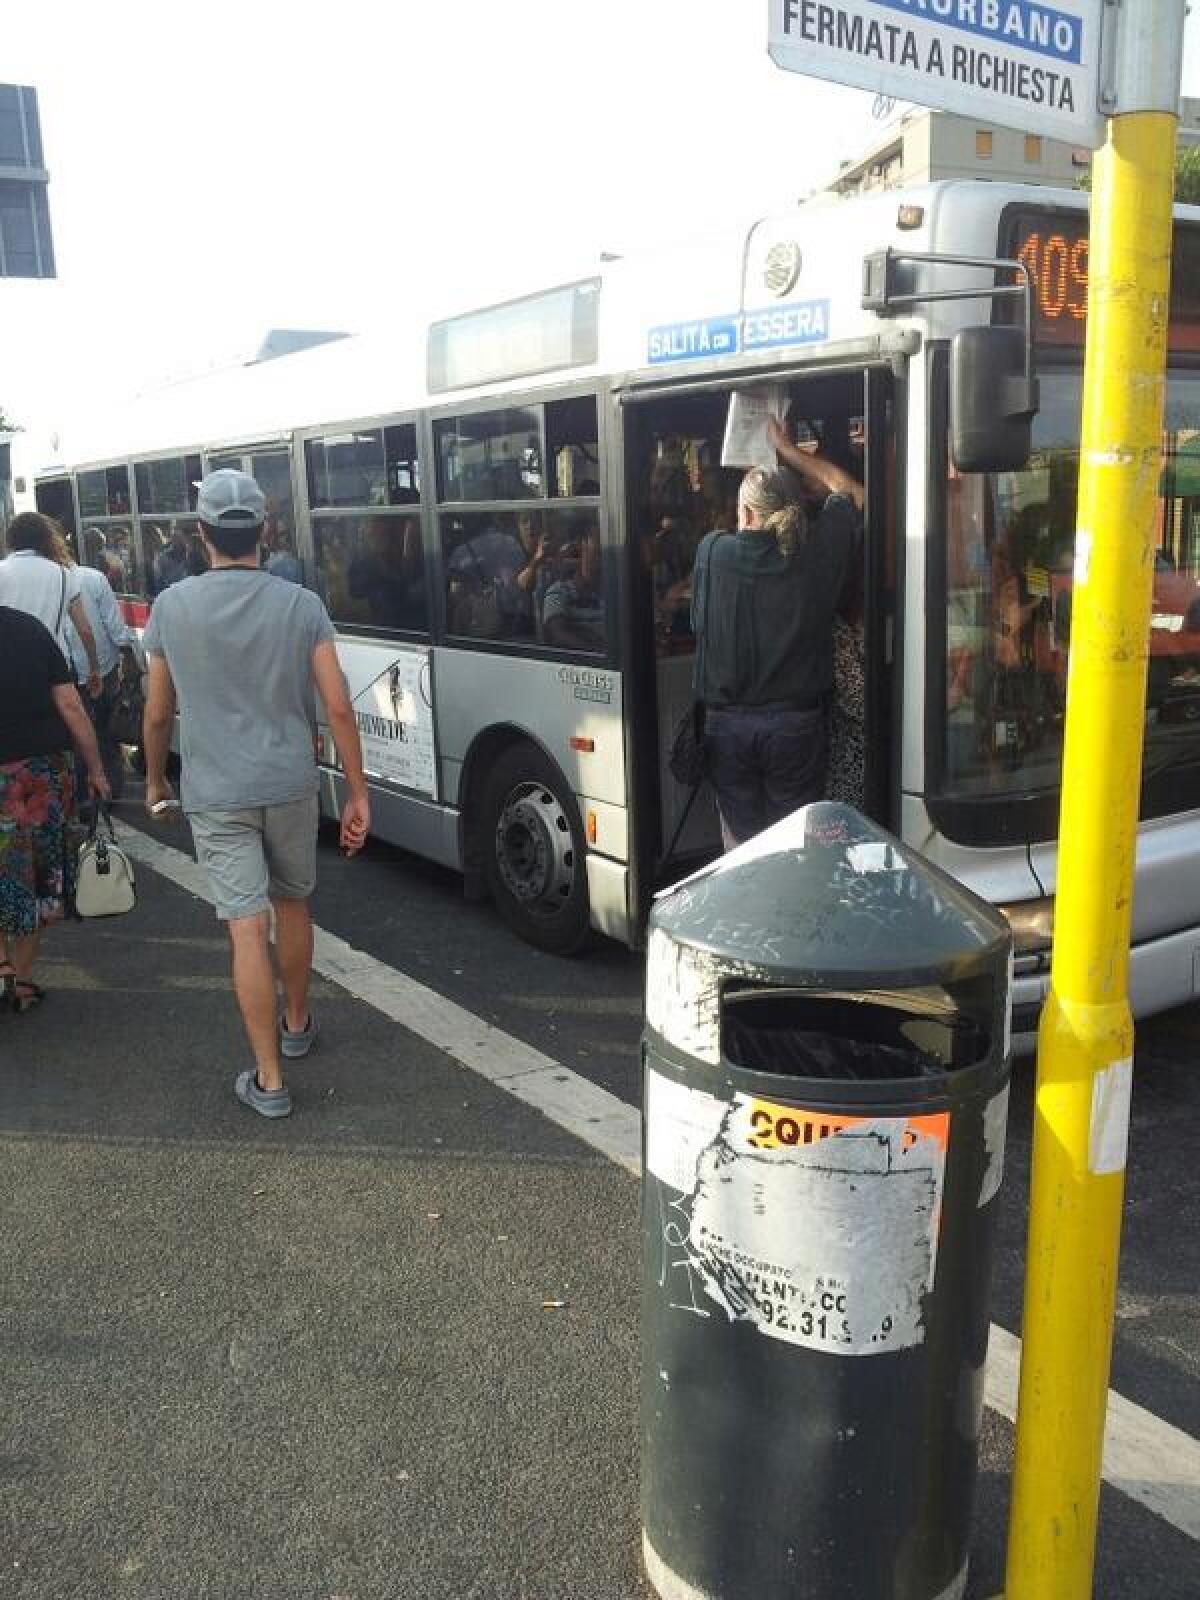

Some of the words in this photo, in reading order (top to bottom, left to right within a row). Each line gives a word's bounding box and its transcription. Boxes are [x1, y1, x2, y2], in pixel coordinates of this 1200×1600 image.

[783, 0, 920, 71] FERMATA
[926, 38, 945, 77] A
[952, 45, 1075, 113] RICHIESTA
[731, 304, 826, 344] TESSERA
